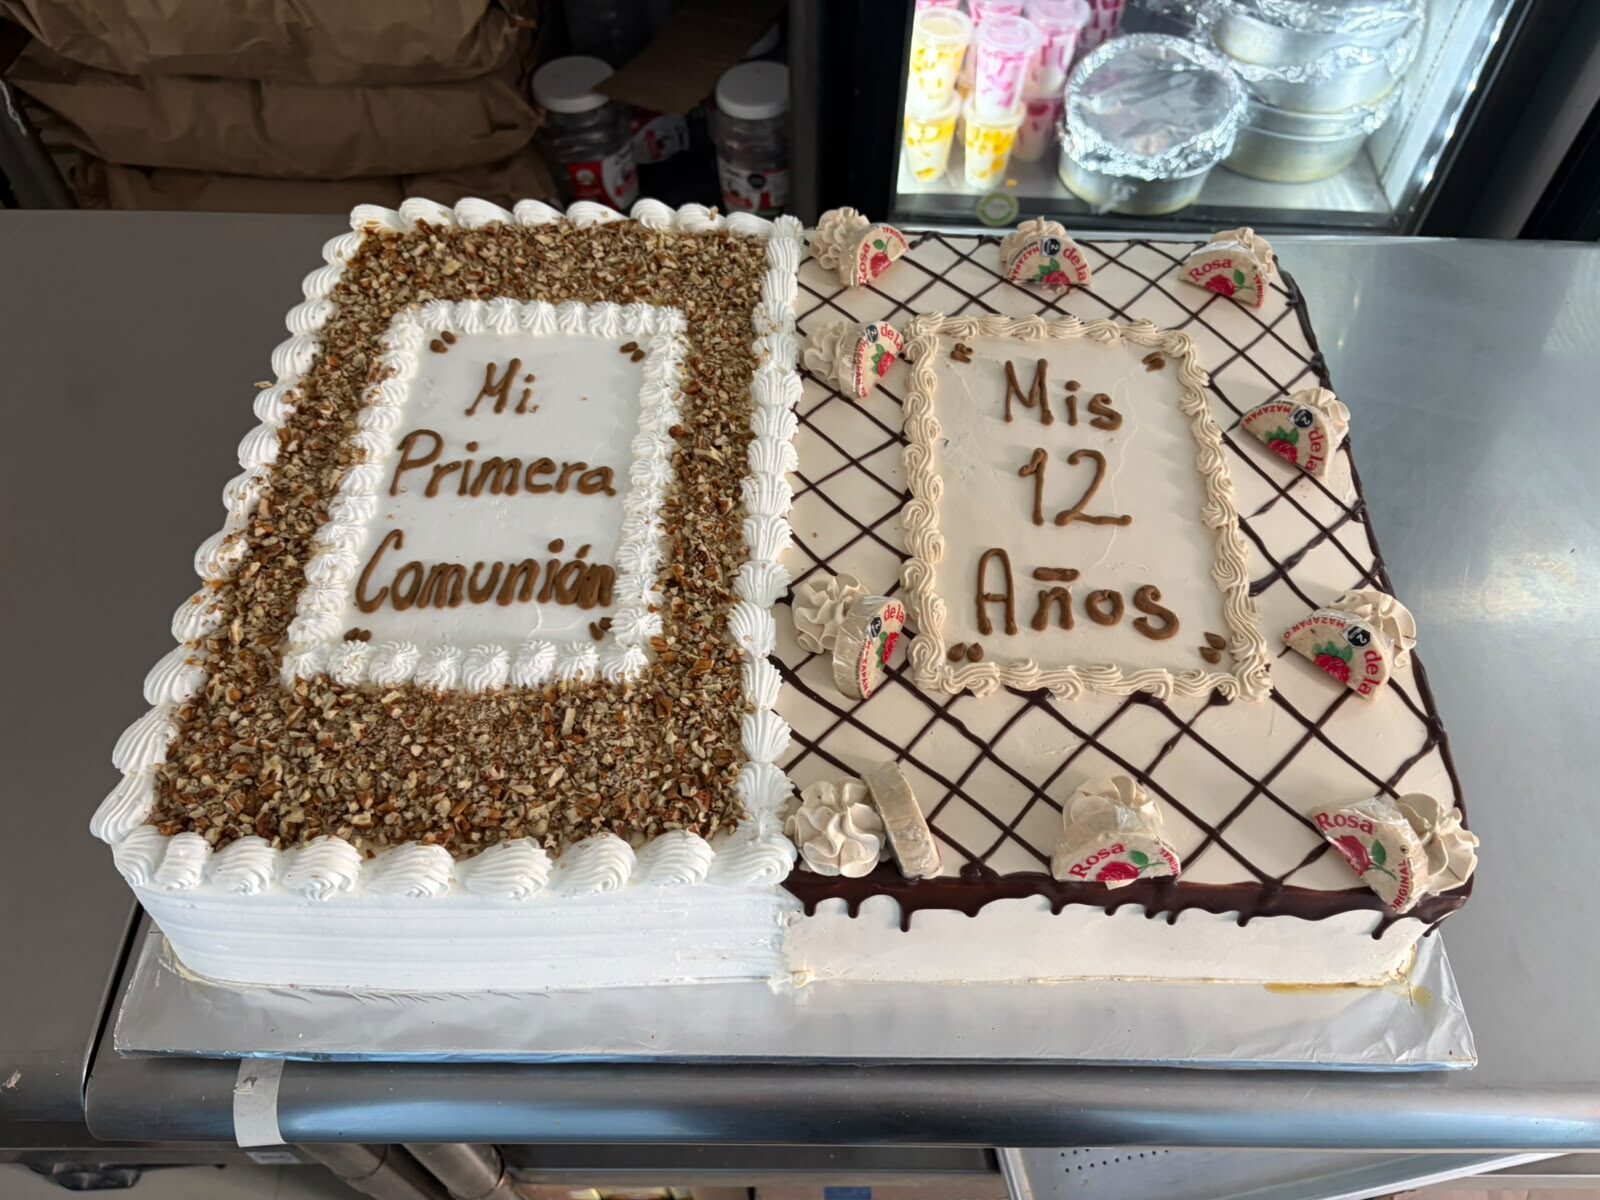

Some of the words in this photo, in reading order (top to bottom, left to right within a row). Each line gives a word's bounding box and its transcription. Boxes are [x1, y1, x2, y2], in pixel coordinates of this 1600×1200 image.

[1063, 247, 1080, 266] de
[1075, 263, 1089, 282] la
[1189, 259, 1233, 282] Rosa
[881, 323, 894, 340] de
[465, 358, 536, 416] Mi
[1004, 358, 1123, 431] Mis
[1308, 427, 1324, 453] de
[389, 429, 616, 498] Primera
[1306, 454, 1324, 470] la
[1018, 447, 1132, 526] 12
[355, 528, 616, 613] Comunión
[976, 547, 1180, 640] Años
[884, 604, 897, 621] de
[896, 604, 905, 624] la
[1364, 650, 1382, 675] de
[1357, 677, 1380, 695] la
[1312, 812, 1375, 836] Rosa
[1068, 843, 1126, 879] Rosa
